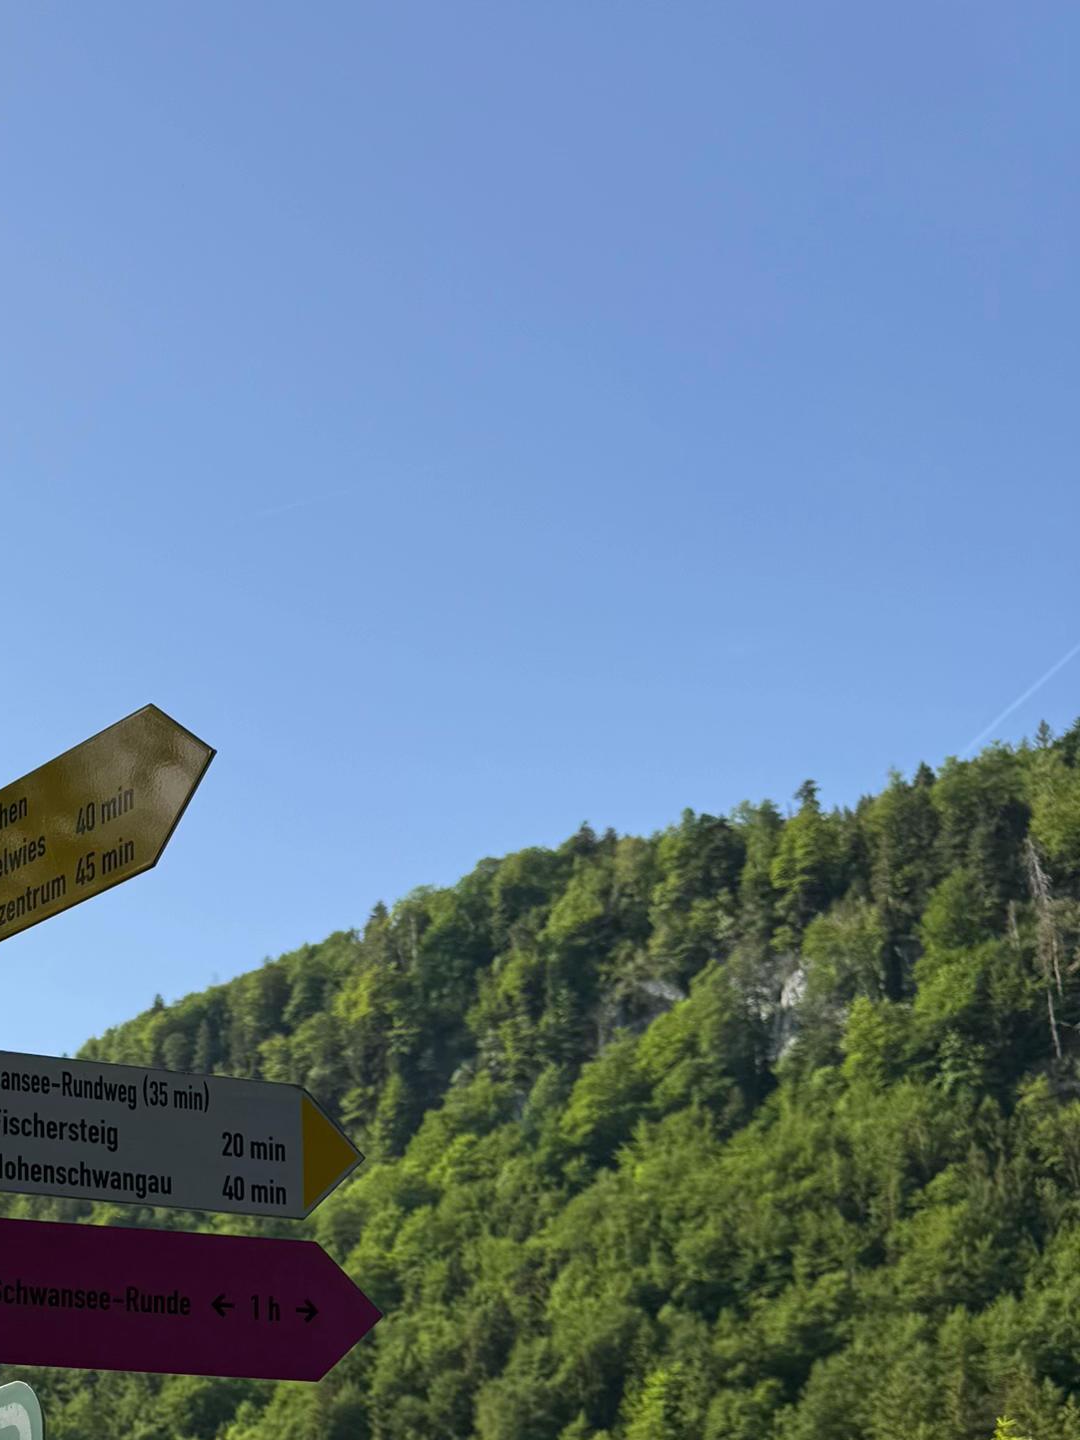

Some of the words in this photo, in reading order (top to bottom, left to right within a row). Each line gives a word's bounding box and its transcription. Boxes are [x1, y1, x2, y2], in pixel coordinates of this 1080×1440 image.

[75, 806, 96, 835] 40
[101, 787, 135, 825] min
[75, 857, 96, 886] 45
[101, 838, 135, 875] min
[142, 1075, 170, 1108] (35
[173, 1080, 210, 1113] min)
[221, 1132, 244, 1158] 20
[249, 1135, 286, 1163] min
[221, 1175, 244, 1201] 40
[250, 1179, 287, 1206] min
[252, 1294, 260, 1318] 1
[266, 1297, 281, 1322] h
